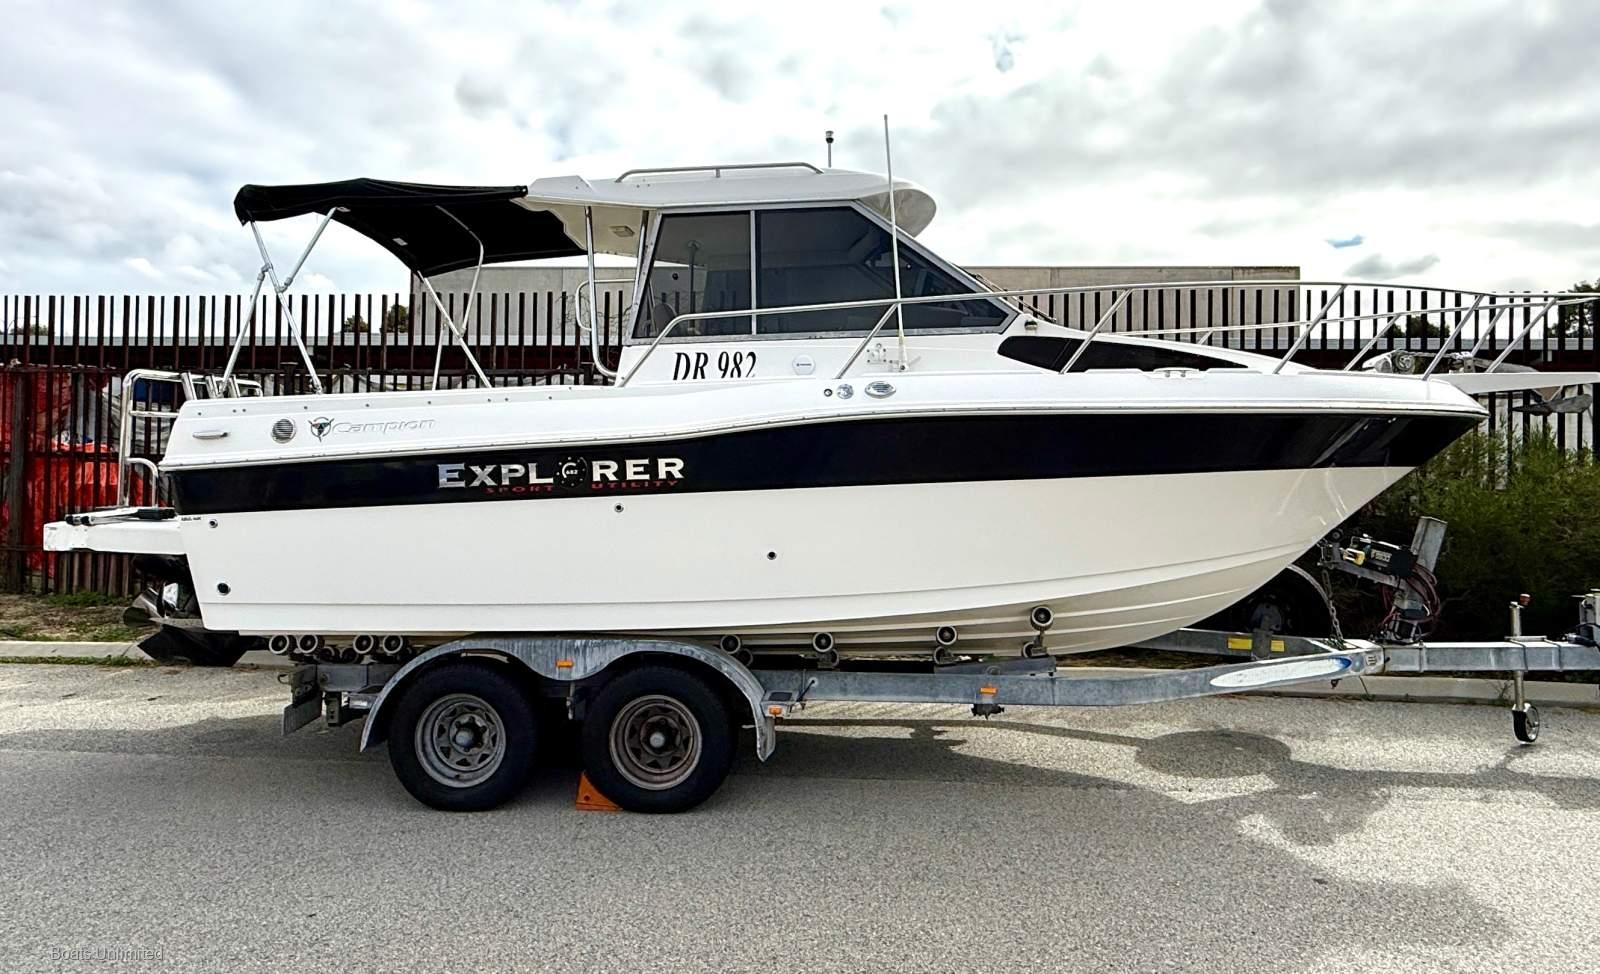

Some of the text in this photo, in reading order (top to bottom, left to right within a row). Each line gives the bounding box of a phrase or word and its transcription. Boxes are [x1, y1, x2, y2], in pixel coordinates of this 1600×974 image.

[673, 351, 757, 381] DR 982
[332, 419, 435, 434] Campion
[485, 480, 679, 494] SPORT UTILITY
